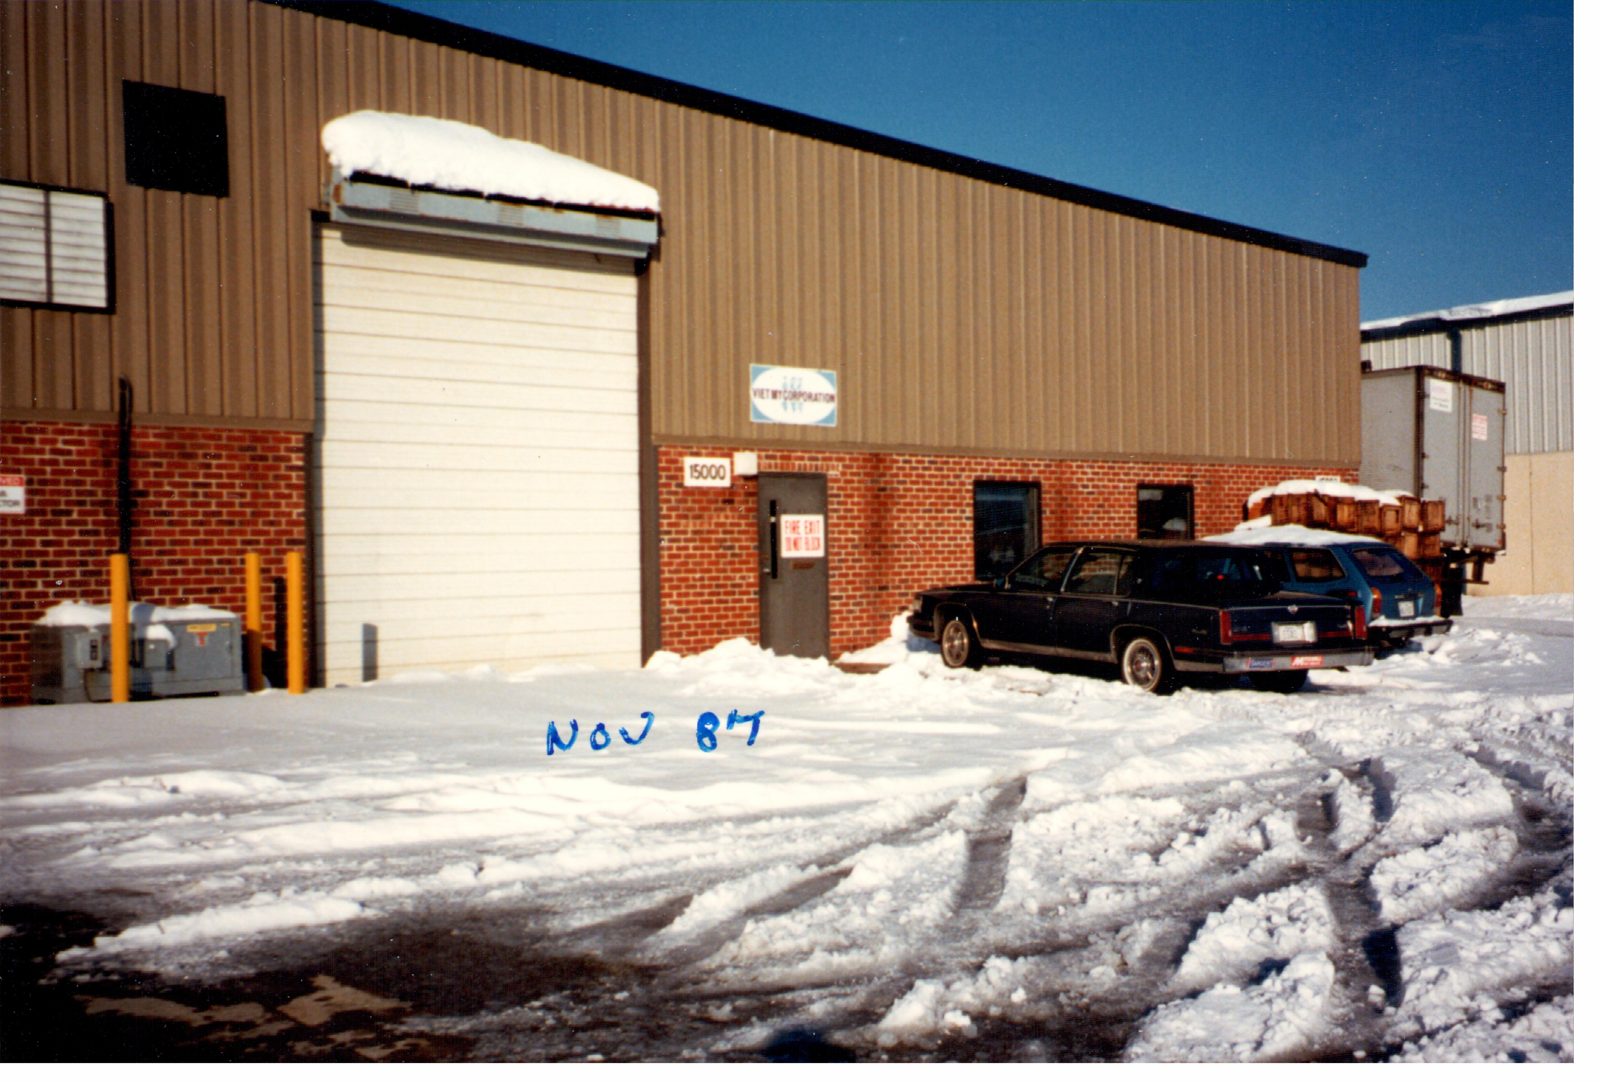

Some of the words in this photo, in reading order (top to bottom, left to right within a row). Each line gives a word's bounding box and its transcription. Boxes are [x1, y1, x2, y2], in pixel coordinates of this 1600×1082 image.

[752, 387, 770, 399] VIET
[783, 390, 835, 403] CORPORATION
[689, 464, 726, 481] 15000
[804, 520, 820, 535] EXIT
